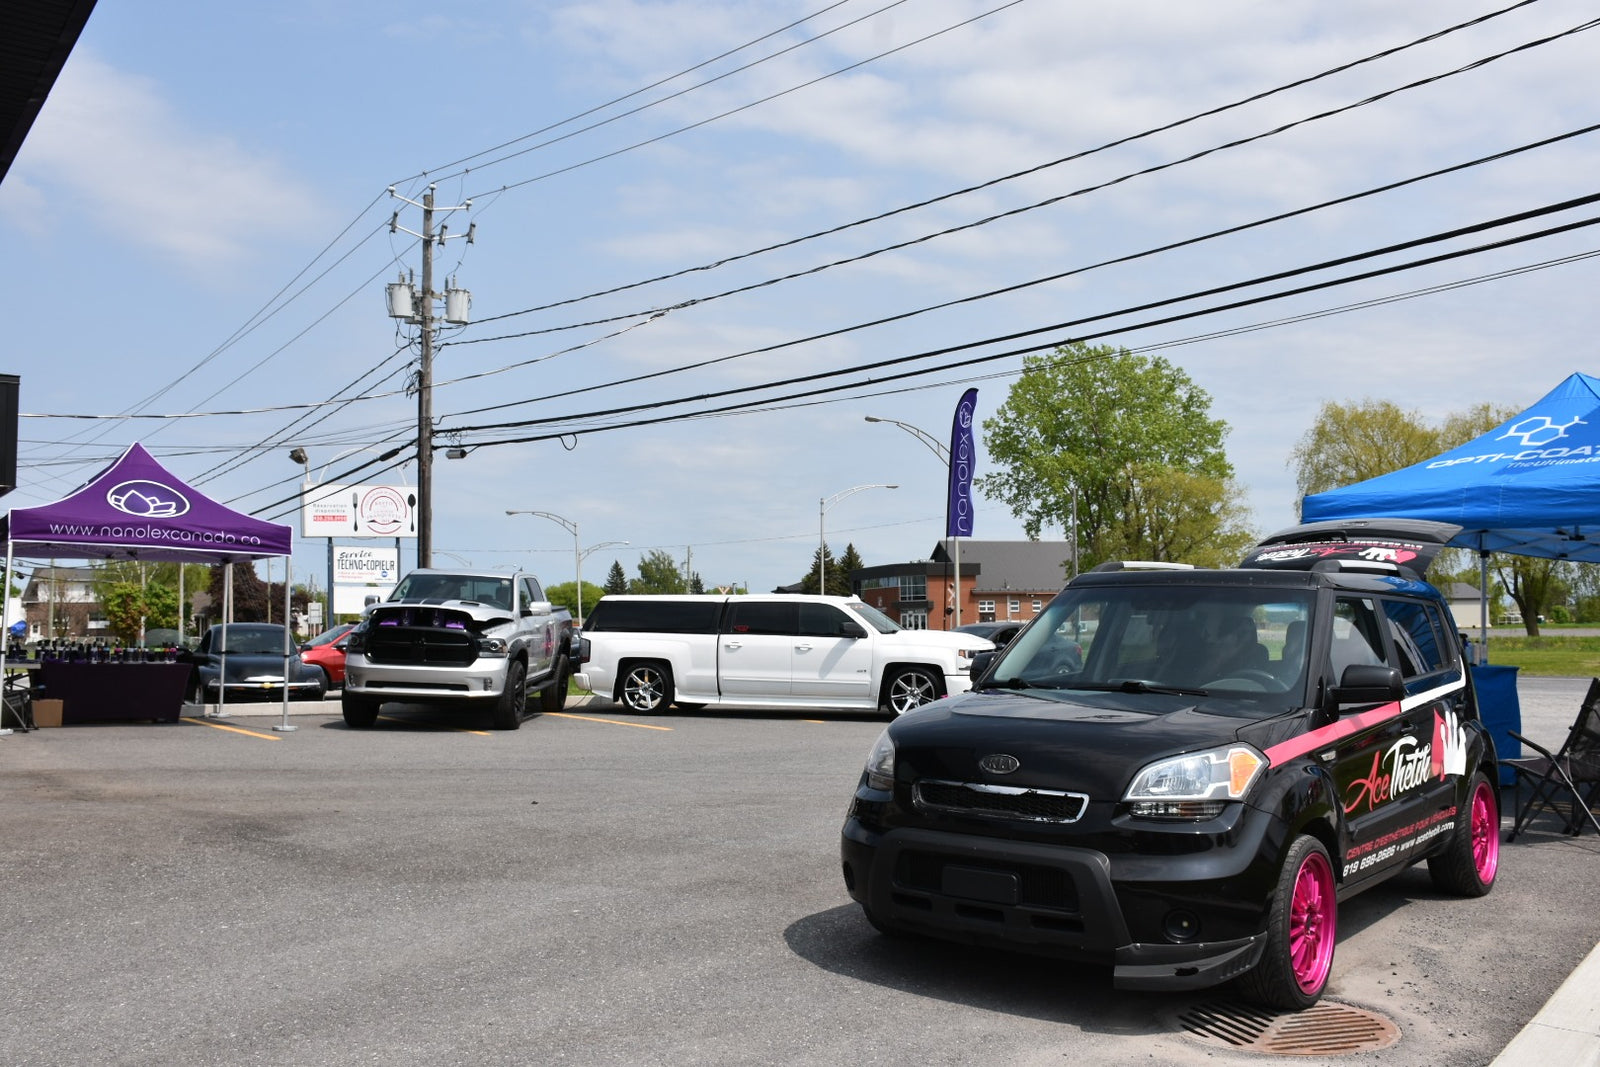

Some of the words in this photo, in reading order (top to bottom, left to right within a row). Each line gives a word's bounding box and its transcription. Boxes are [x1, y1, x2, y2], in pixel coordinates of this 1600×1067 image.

[956, 432, 969, 532] nanolex
[49, 524, 261, 545] www.nanolexcanadaca
[1346, 840, 1374, 860] CENTRE
[1342, 861, 1360, 877] 819
